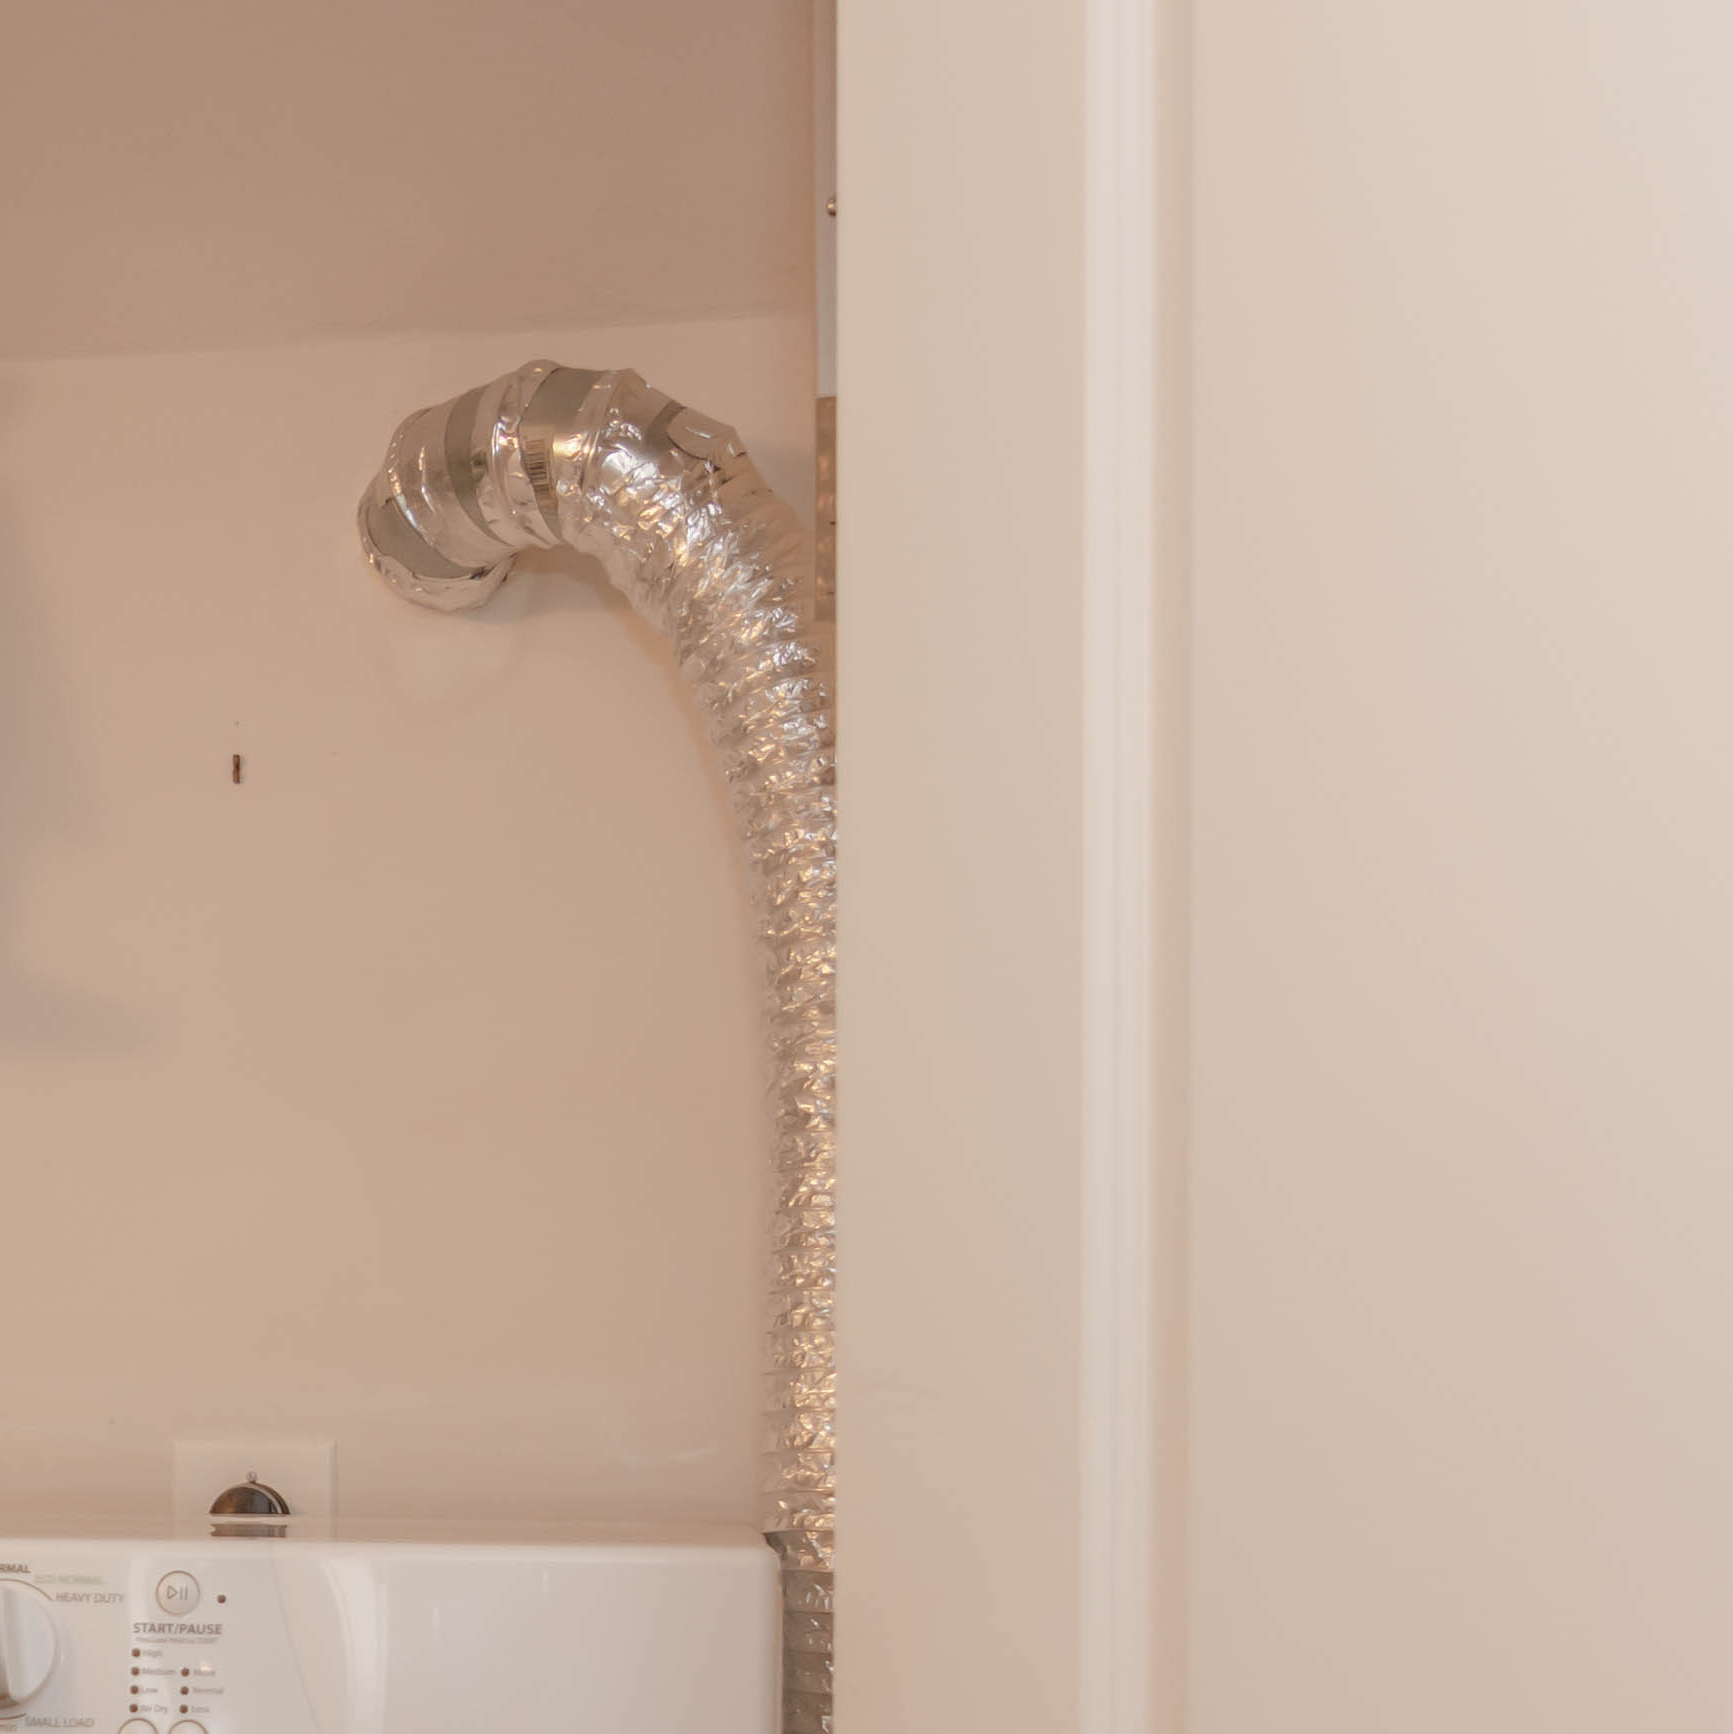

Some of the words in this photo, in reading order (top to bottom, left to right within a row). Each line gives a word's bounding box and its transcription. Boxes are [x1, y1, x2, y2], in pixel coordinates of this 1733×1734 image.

[55, 1592, 92, 1603] HEAVY
[94, 1593, 125, 1604] DUTY
[133, 1622, 223, 1635] START/PAUSE
[24, 1717, 62, 1728] SMALL
[63, 1717, 95, 1728] LOAD
